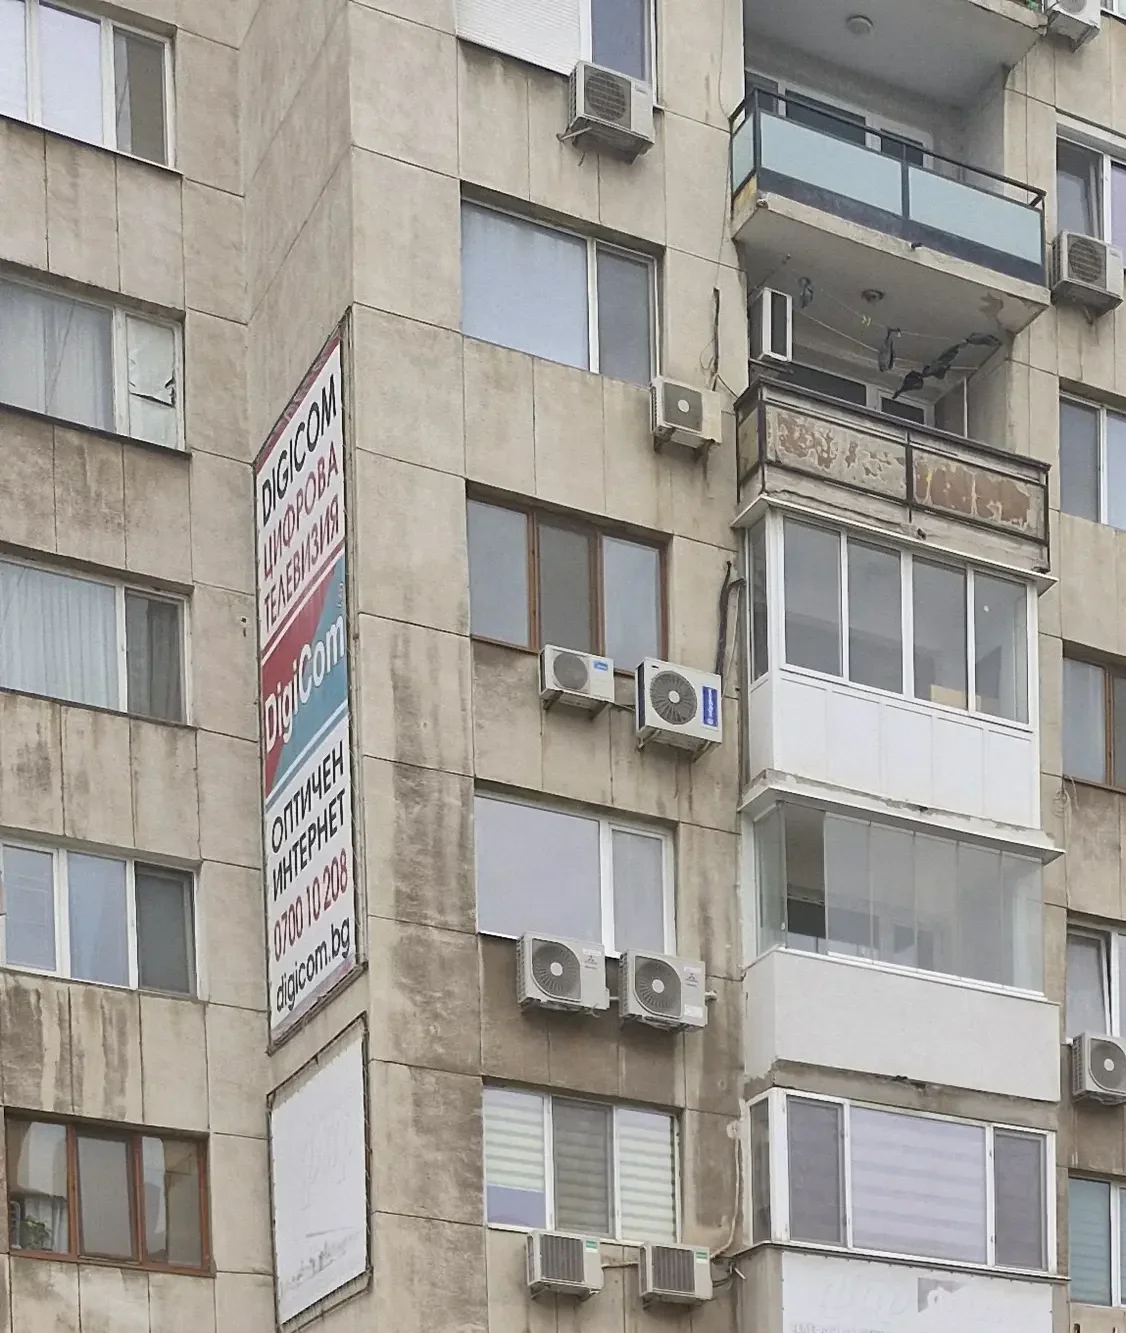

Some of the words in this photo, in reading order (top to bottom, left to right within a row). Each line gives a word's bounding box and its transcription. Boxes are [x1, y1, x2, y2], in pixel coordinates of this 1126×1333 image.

[261, 372, 338, 528] DIGICOM
[263, 440, 339, 582] ЦИФРОВА
[264, 493, 341, 634] ТЕЛЕВИЗИЯ
[264, 614, 346, 755] DigiCom
[271, 739, 345, 854] ОПТИЧЕН
[272, 788, 346, 902] ИНТЕРНЕТ
[273, 892, 303, 963] 0700
[305, 884, 321, 929] 10
[323, 847, 349, 912] 208
[275, 916, 352, 1013] digicom.bg
